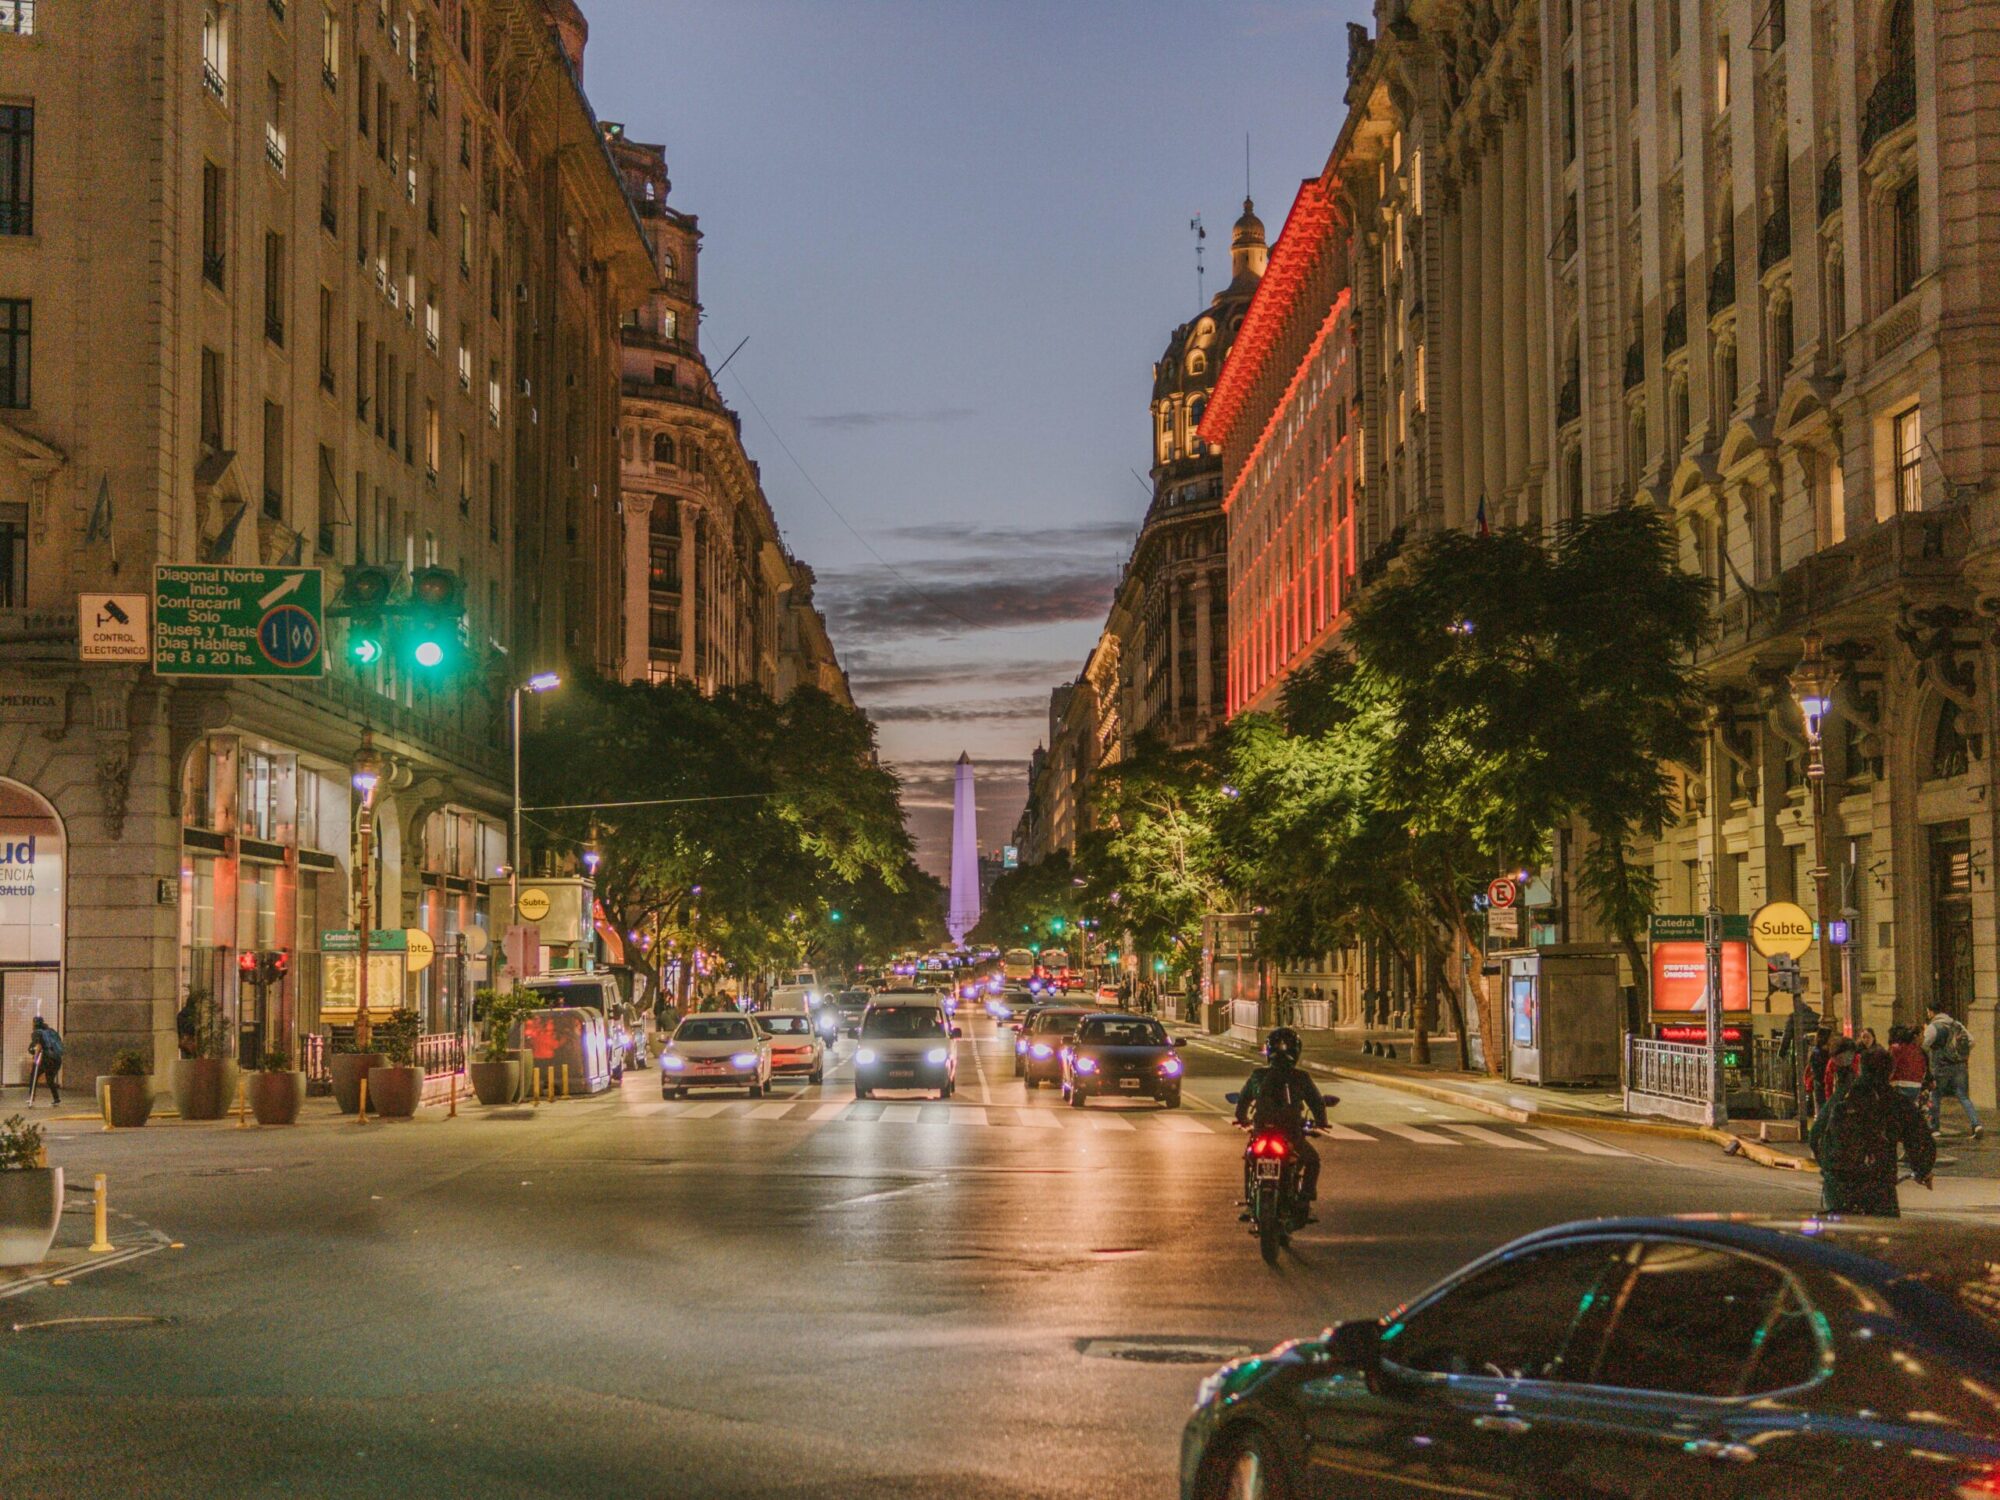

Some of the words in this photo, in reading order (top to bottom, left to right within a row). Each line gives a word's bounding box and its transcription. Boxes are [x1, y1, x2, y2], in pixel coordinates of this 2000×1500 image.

[157, 567, 219, 583] Diagonal
[223, 570, 265, 583] Norte
[190, 583, 228, 596] Inicio
[157, 595, 241, 610] Contracarril
[188, 610, 221, 623] Solo
[157, 622, 202, 636] Buses
[207, 626, 216, 638] y
[220, 624, 257, 638] Taxis
[93, 633, 136, 642] CONTROL
[83, 646, 146, 655] ELECTRONICO
[157, 650, 176, 662] de
[181, 652, 191, 663] 8
[196, 653, 205, 664] a
[211, 652, 230, 664] 20
[235, 653, 256, 665] hs.
[522, 898, 547, 906] Subte
[1655, 918, 1695, 927] Catedral
[1761, 921, 1805, 935] Subte
[1836, 927, 1843, 937] E
